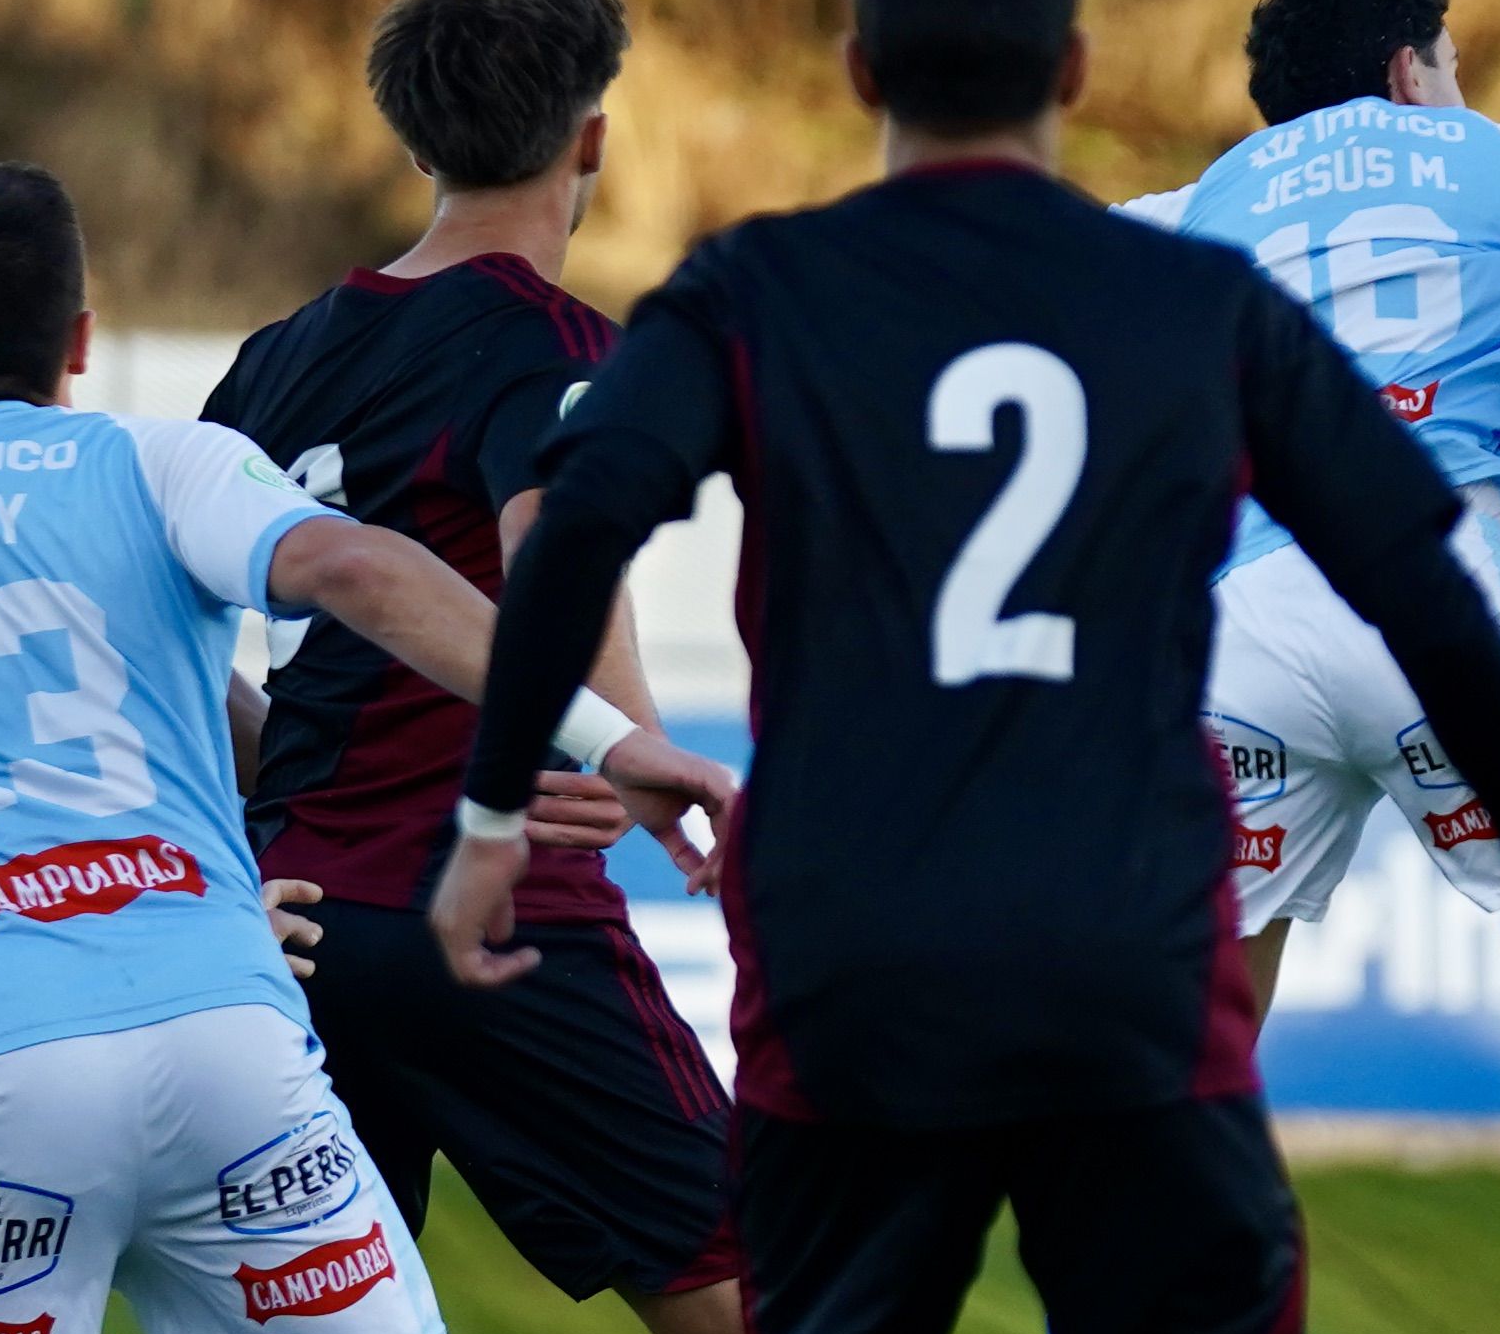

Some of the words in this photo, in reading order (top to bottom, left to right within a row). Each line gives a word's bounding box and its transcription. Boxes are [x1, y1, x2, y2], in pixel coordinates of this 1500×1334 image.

[1250, 135, 1396, 214] JESÚS
[1410, 151, 1460, 192] M.
[1254, 204, 1463, 354] 16
[926, 340, 1089, 688] 2
[1399, 741, 1446, 775] EL
[218, 1183, 267, 1219] EL
[250, 1237, 389, 1311] CAMPOARAS
